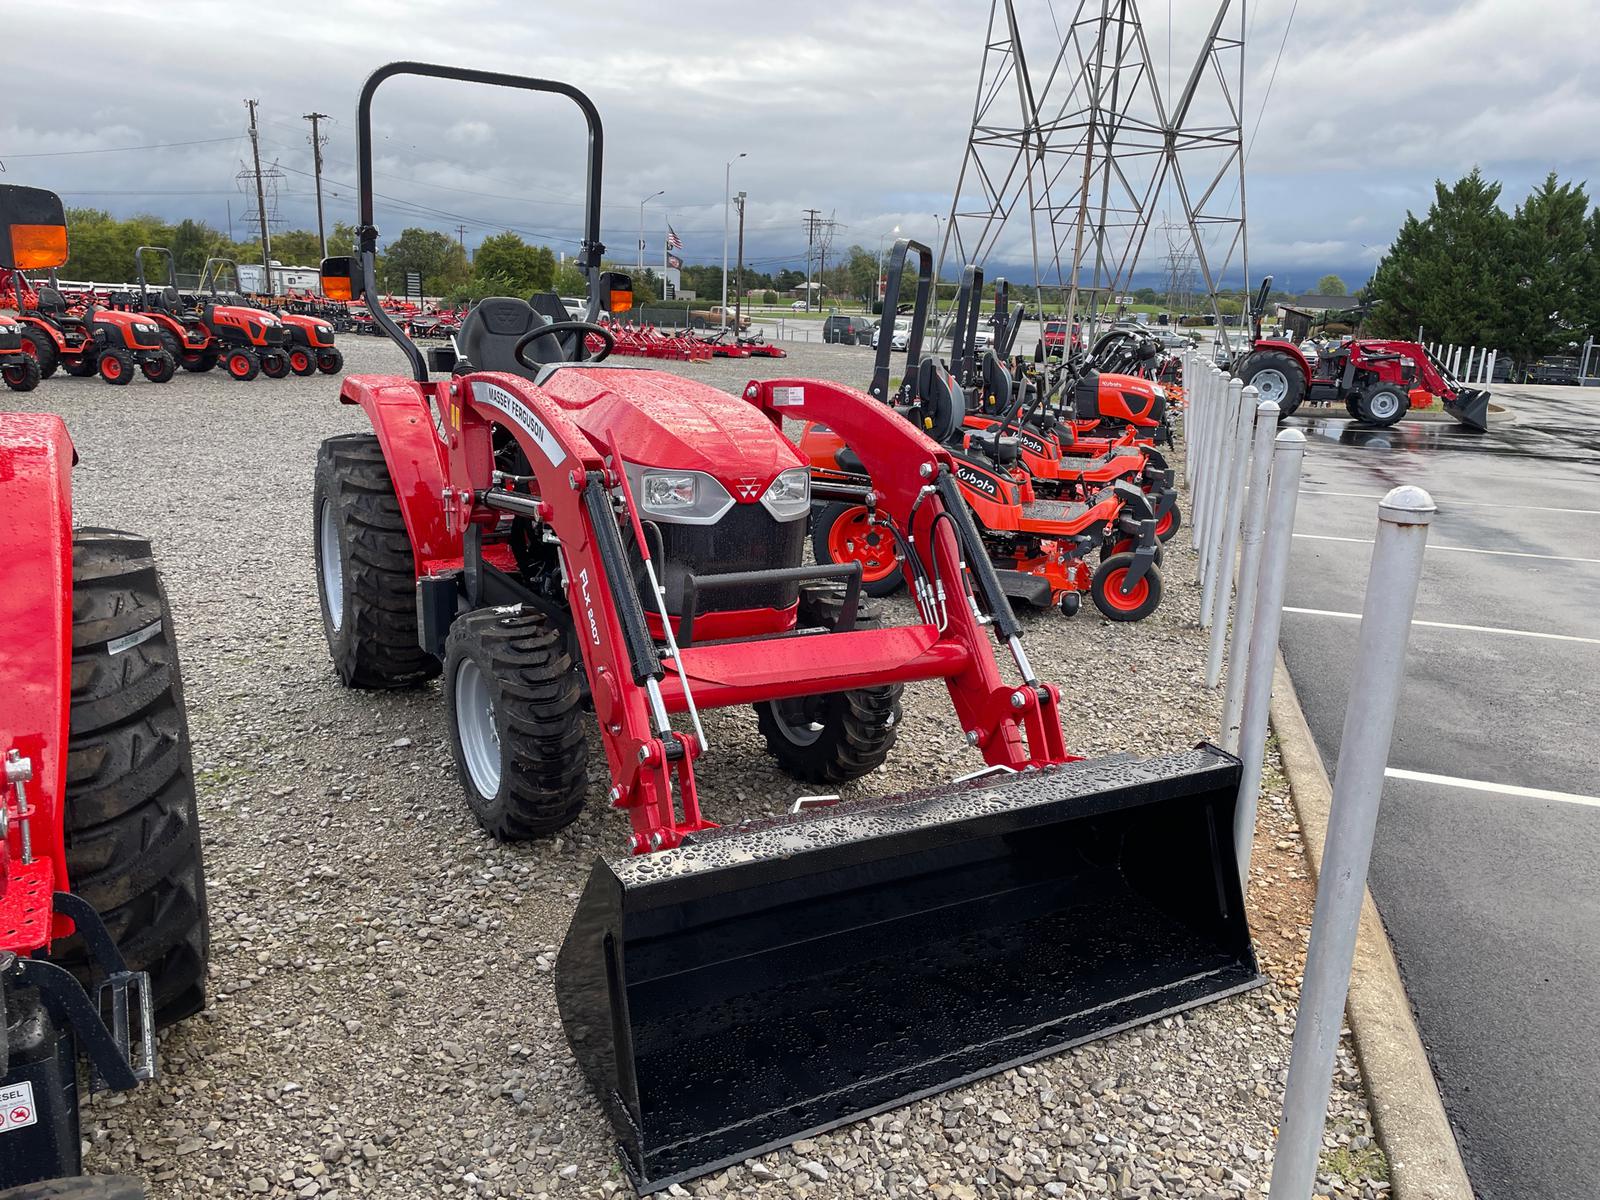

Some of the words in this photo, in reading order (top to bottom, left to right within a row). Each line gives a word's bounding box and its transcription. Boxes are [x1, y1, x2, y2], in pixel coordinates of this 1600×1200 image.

[488, 387, 511, 411] MASSEY
[511, 400, 545, 443] FERGUSON
[587, 607, 601, 646] 2407
